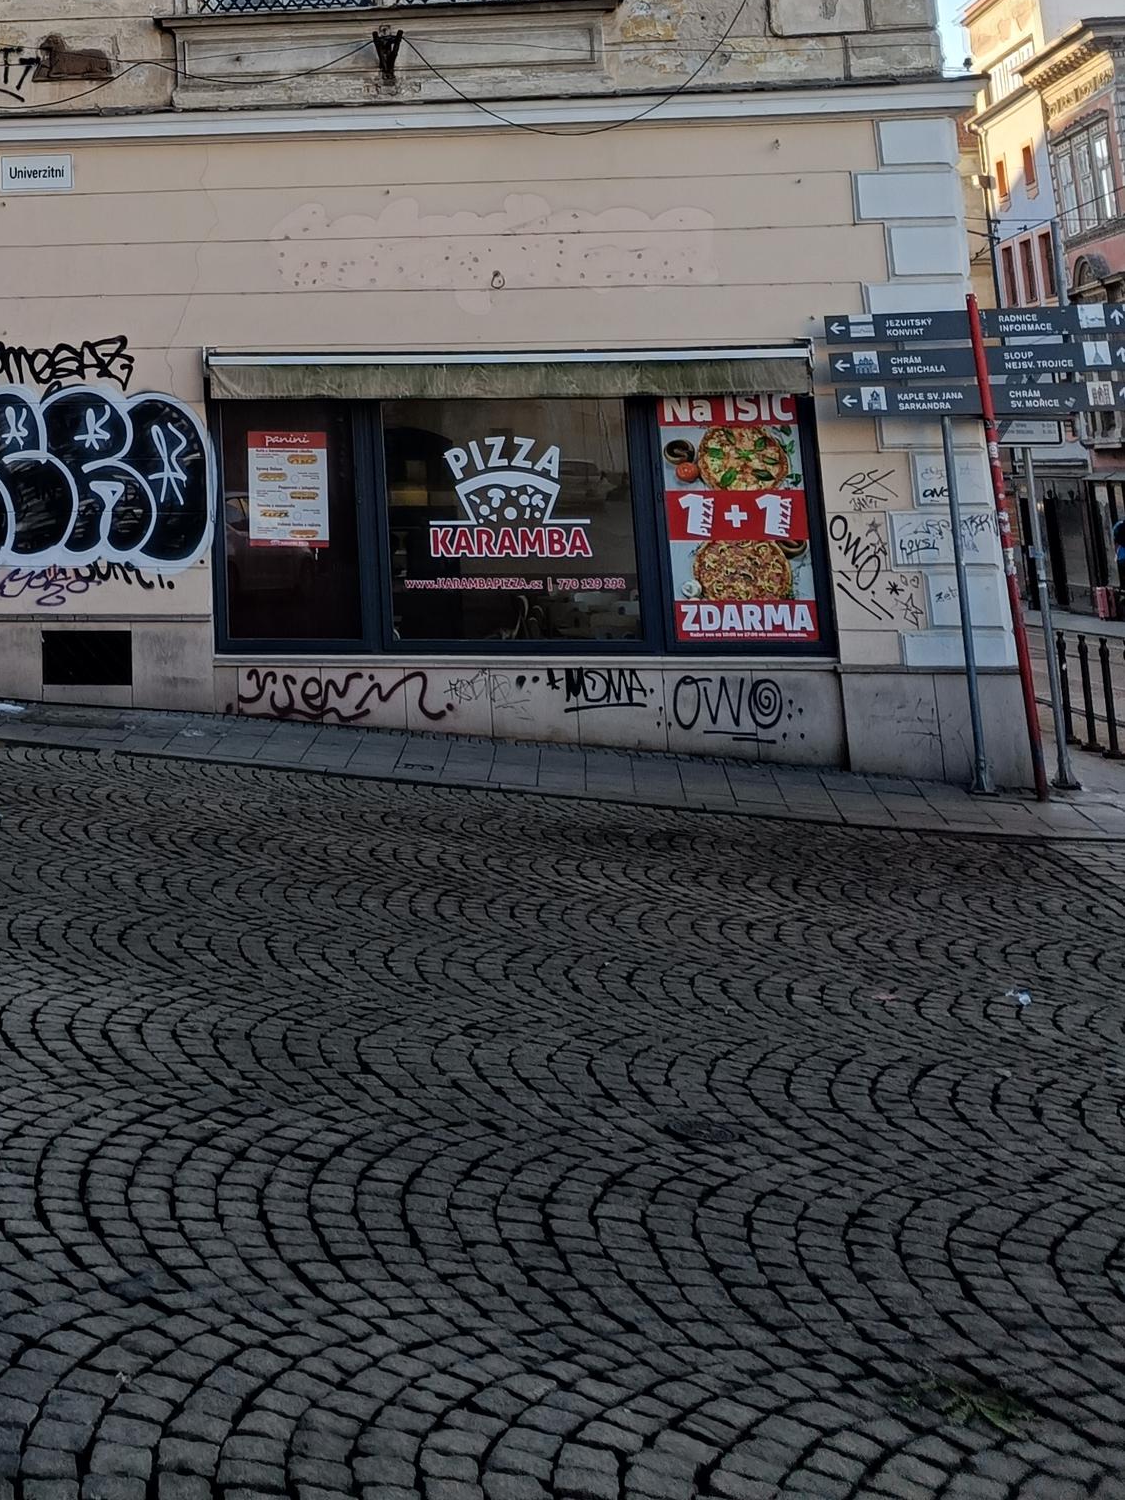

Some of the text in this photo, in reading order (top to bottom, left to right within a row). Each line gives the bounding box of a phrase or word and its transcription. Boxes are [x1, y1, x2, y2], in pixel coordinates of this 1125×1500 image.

[9, 165, 64, 180] Univerzitní
[885, 318, 932, 328] JEZUITSKÝ
[998, 314, 1038, 322] RADNICE
[886, 328, 924, 336] KONVIKT
[999, 323, 1053, 332] INFORMACE
[890, 356, 922, 365] CHRÁM
[1003, 351, 1034, 360] SLOUP
[1005, 359, 1074, 370] NEJSV. TROJICE
[891, 365, 946, 375] SV. MICHALA
[897, 392, 964, 401] KAPLE SV. JANA
[1009, 389, 1041, 398] CHRÁM
[663, 393, 794, 423] Na ISIC
[898, 402, 952, 411] SARKANDRA
[1010, 398, 1060, 408] SV. MOŘICE
[265, 434, 310, 446] panini
[443, 436, 561, 480] PIZZA
[678, 493, 711, 537] 1
[755, 493, 789, 537] 1
[699, 497, 715, 536] PIZZA
[777, 497, 793, 536] PIZZA
[429, 526, 593, 558] KARAMBA
[404, 577, 543, 590] www.KARAMBAPIZZA.cz
[557, 578, 579, 589] 770
[581, 578, 603, 589] 129
[604, 578, 626, 589] 292
[680, 604, 815, 632] ZDARMA
